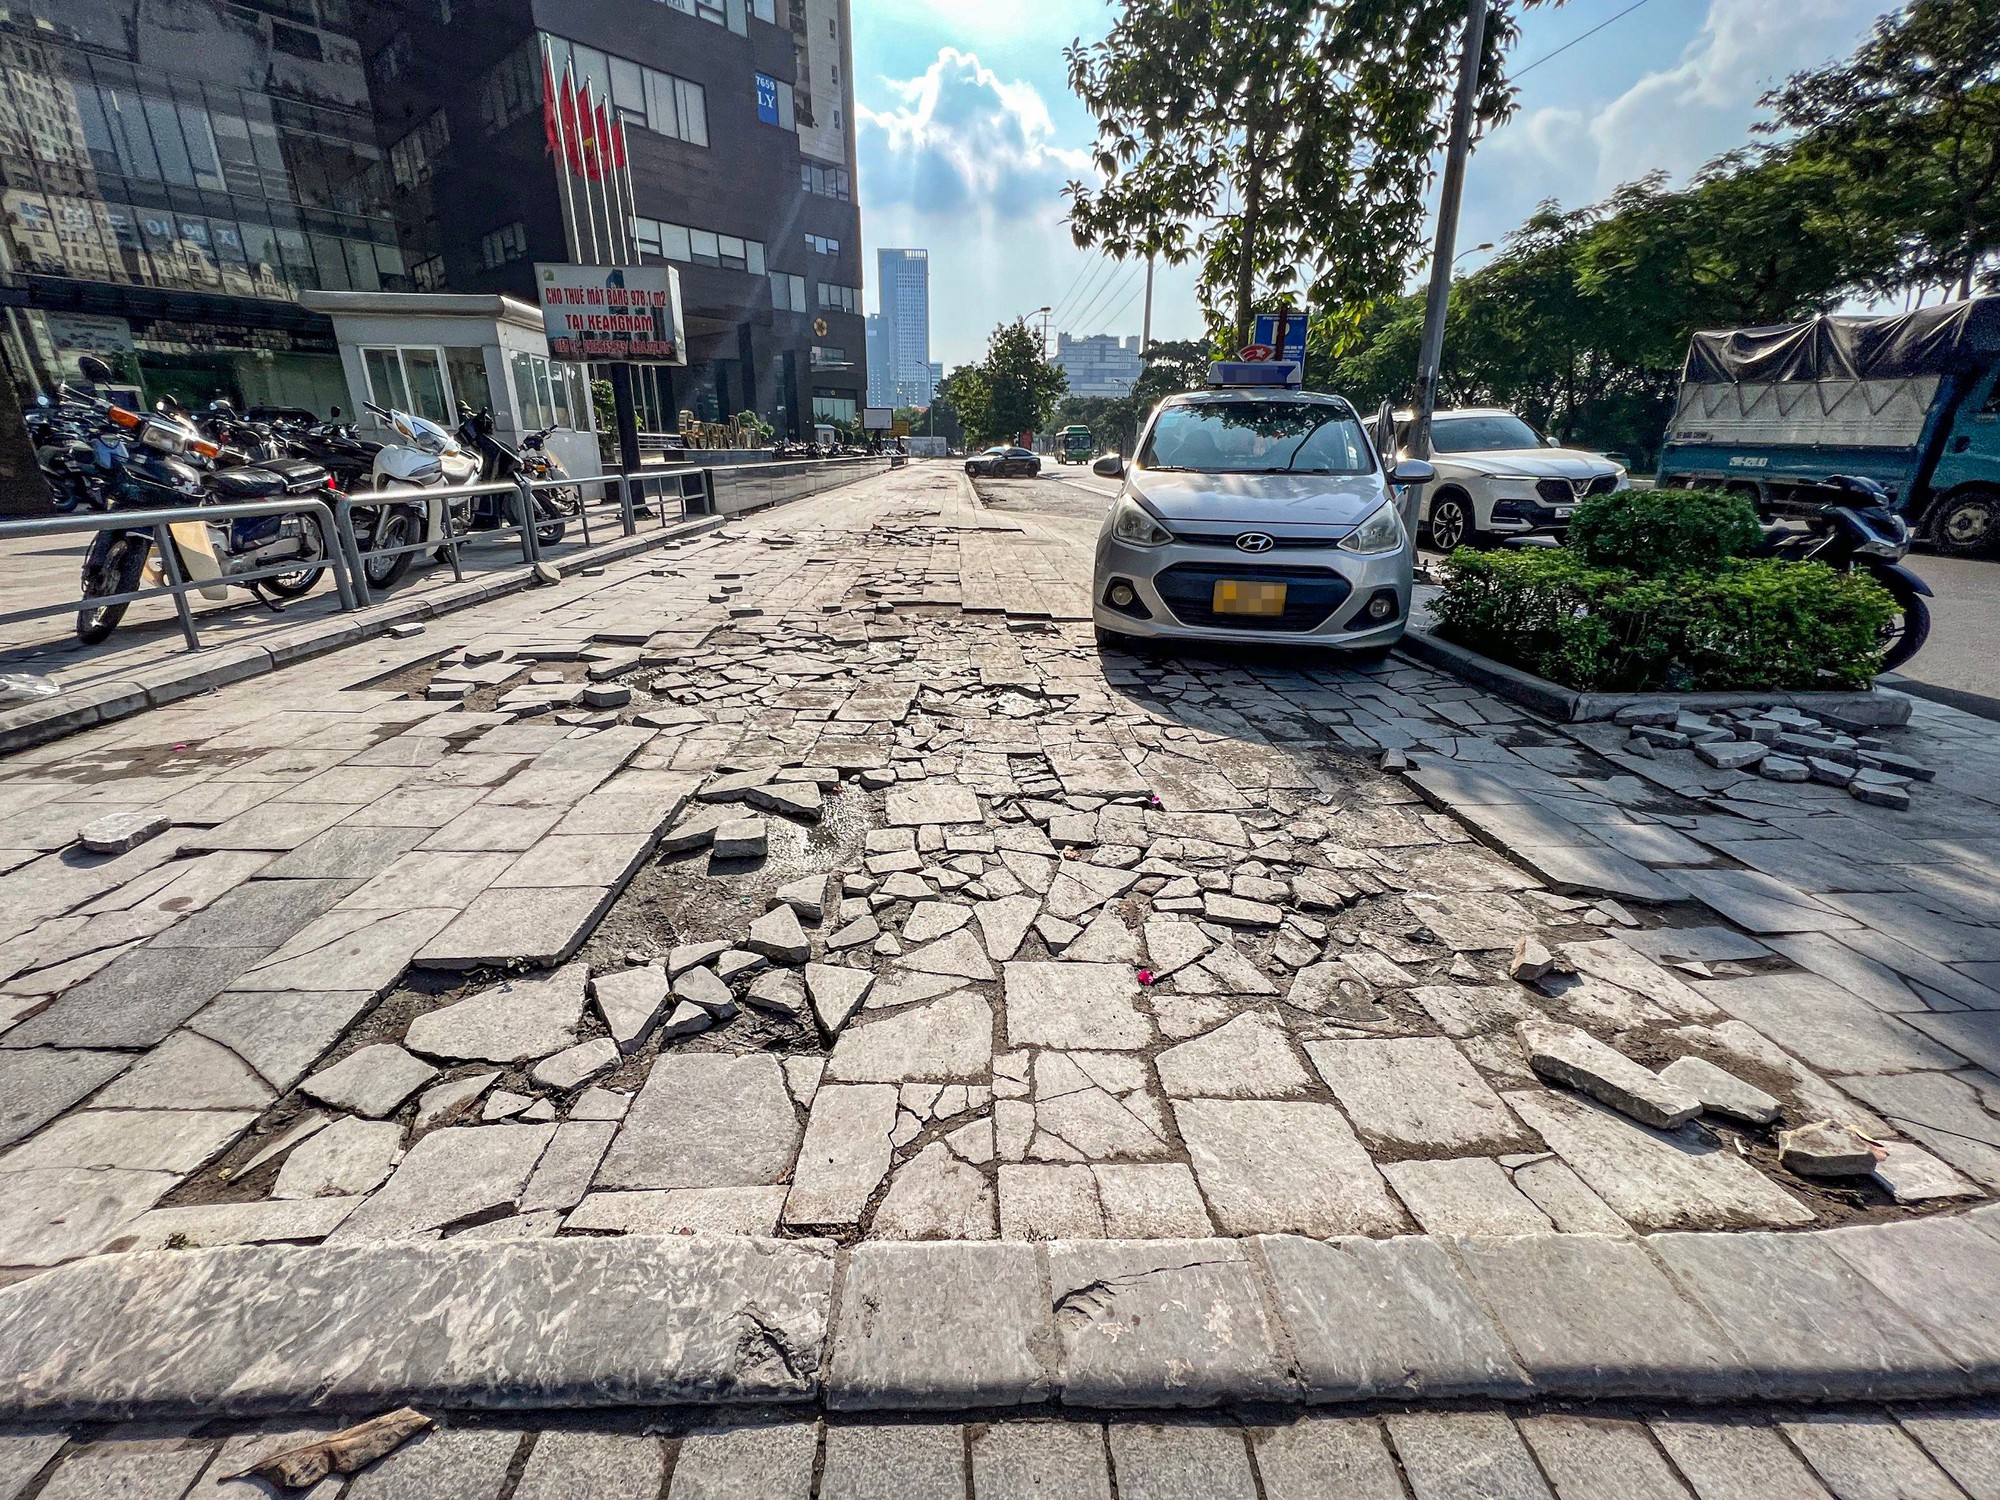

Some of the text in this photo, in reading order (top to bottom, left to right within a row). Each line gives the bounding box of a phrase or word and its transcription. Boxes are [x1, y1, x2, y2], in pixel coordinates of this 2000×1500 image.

[755, 76, 775, 90] 7659
[757, 91, 775, 108] LY
[545, 288, 562, 304] CHO
[653, 291, 666, 306] m2
[587, 314, 653, 331] KEANGNAM
